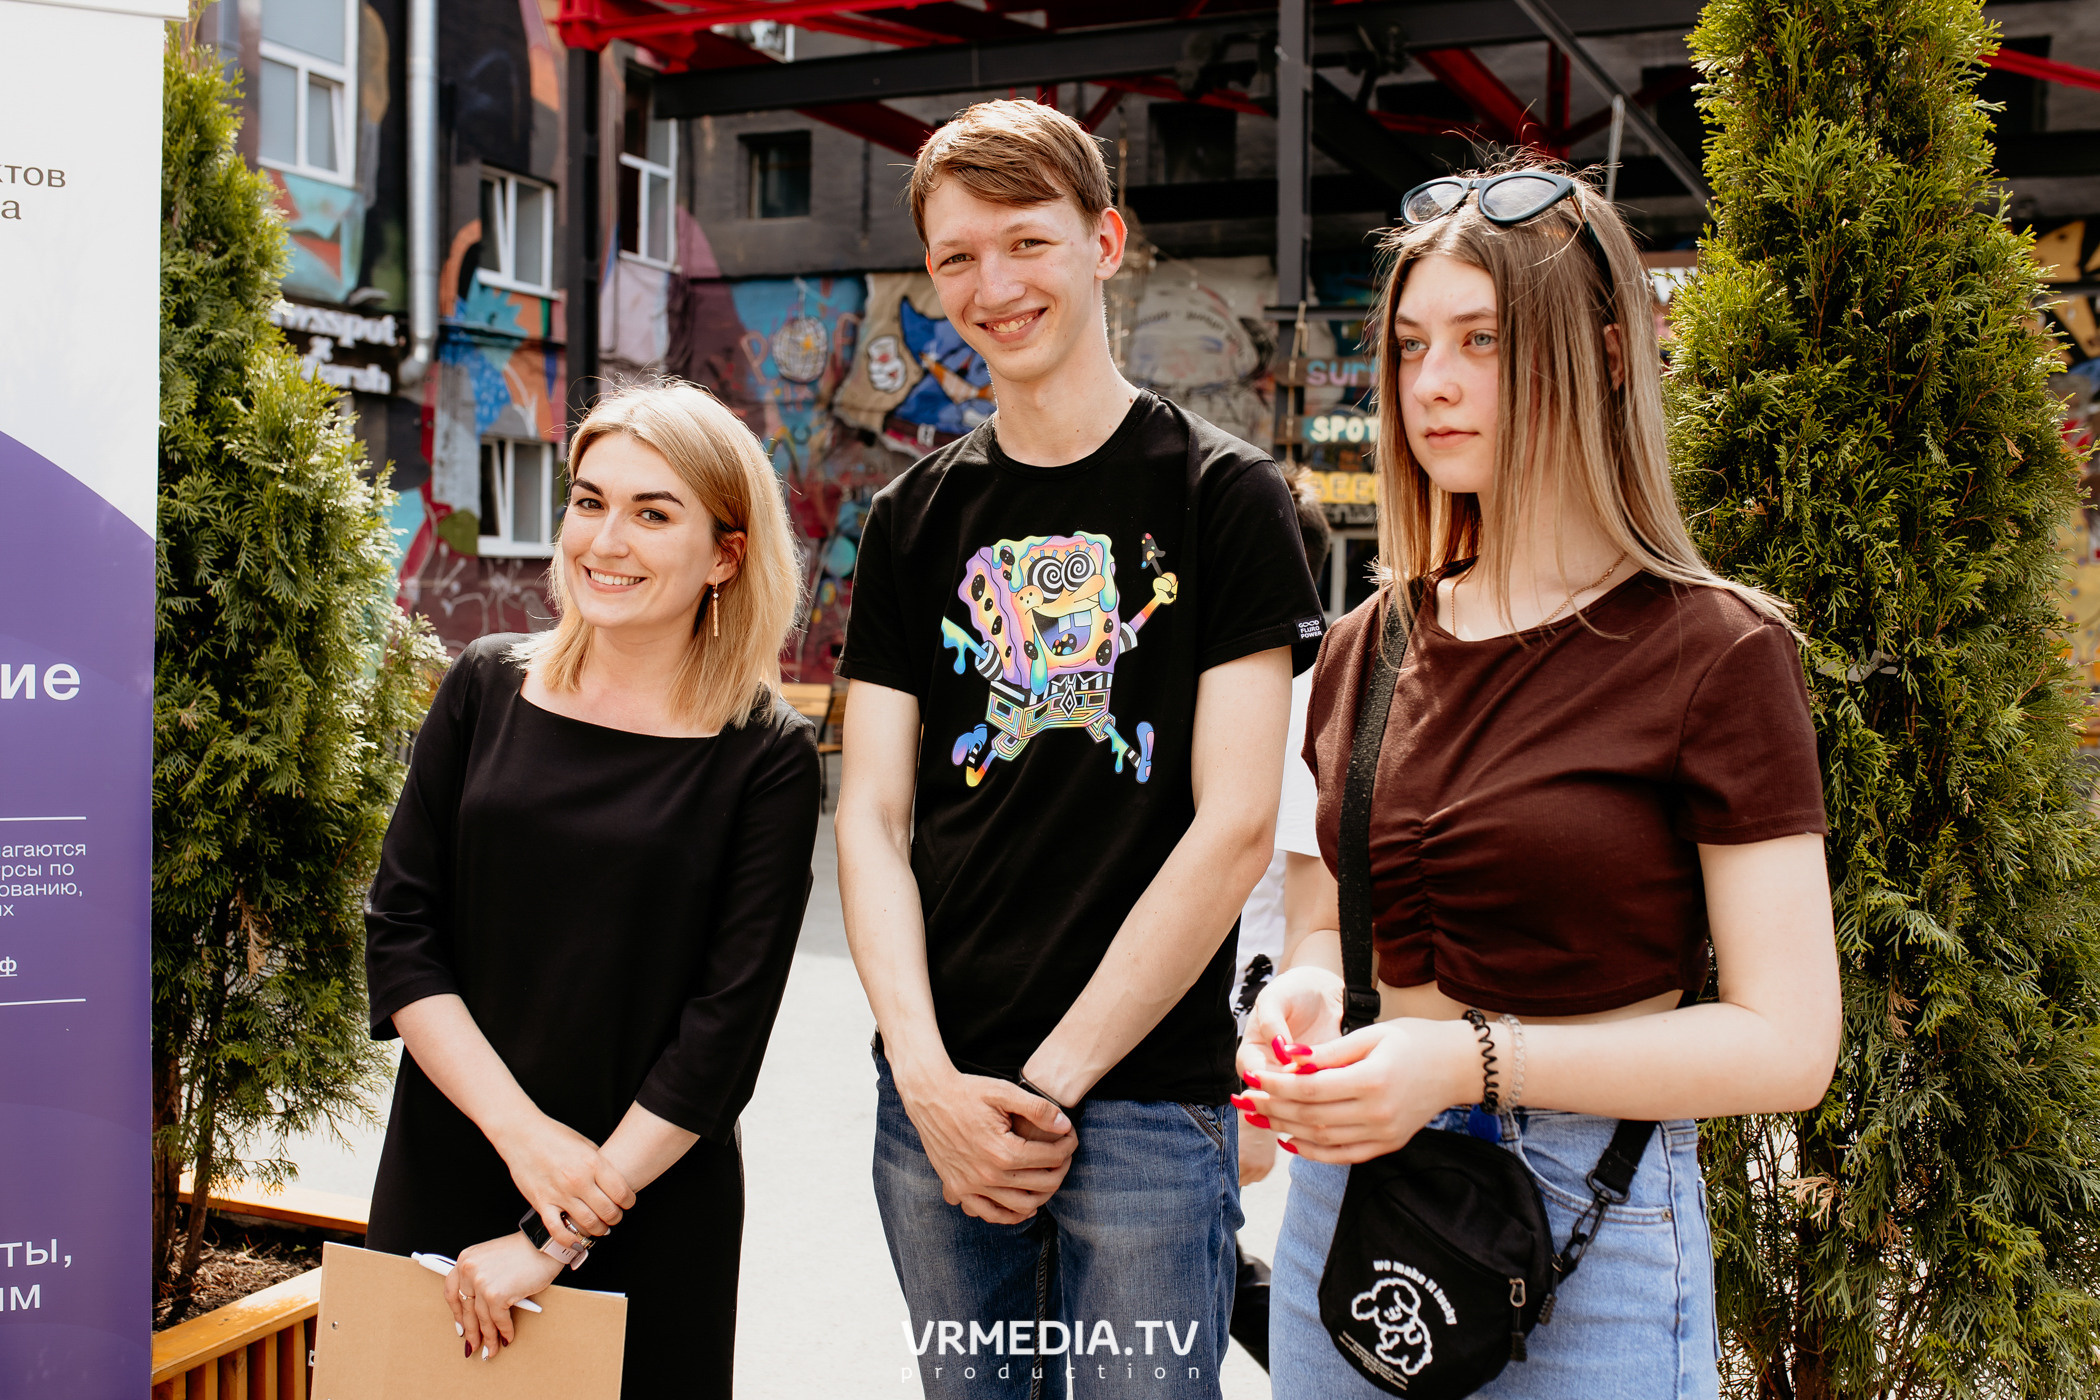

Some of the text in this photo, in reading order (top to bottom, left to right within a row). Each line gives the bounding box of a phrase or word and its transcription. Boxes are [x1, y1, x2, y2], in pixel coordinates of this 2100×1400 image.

[0, 164, 66, 188] тов
[1, 200, 22, 220] а
[1309, 415, 1381, 443] SPOT
[1298, 620, 1320, 628] GOOD
[1300, 631, 1323, 639] POWER
[1, 663, 80, 700] ие
[0, 844, 86, 858] агаются
[50, 863, 75, 876] по
[0, 904, 15, 917] х
[0, 1238, 72, 1268] ты,
[0, 1284, 41, 1312] м
